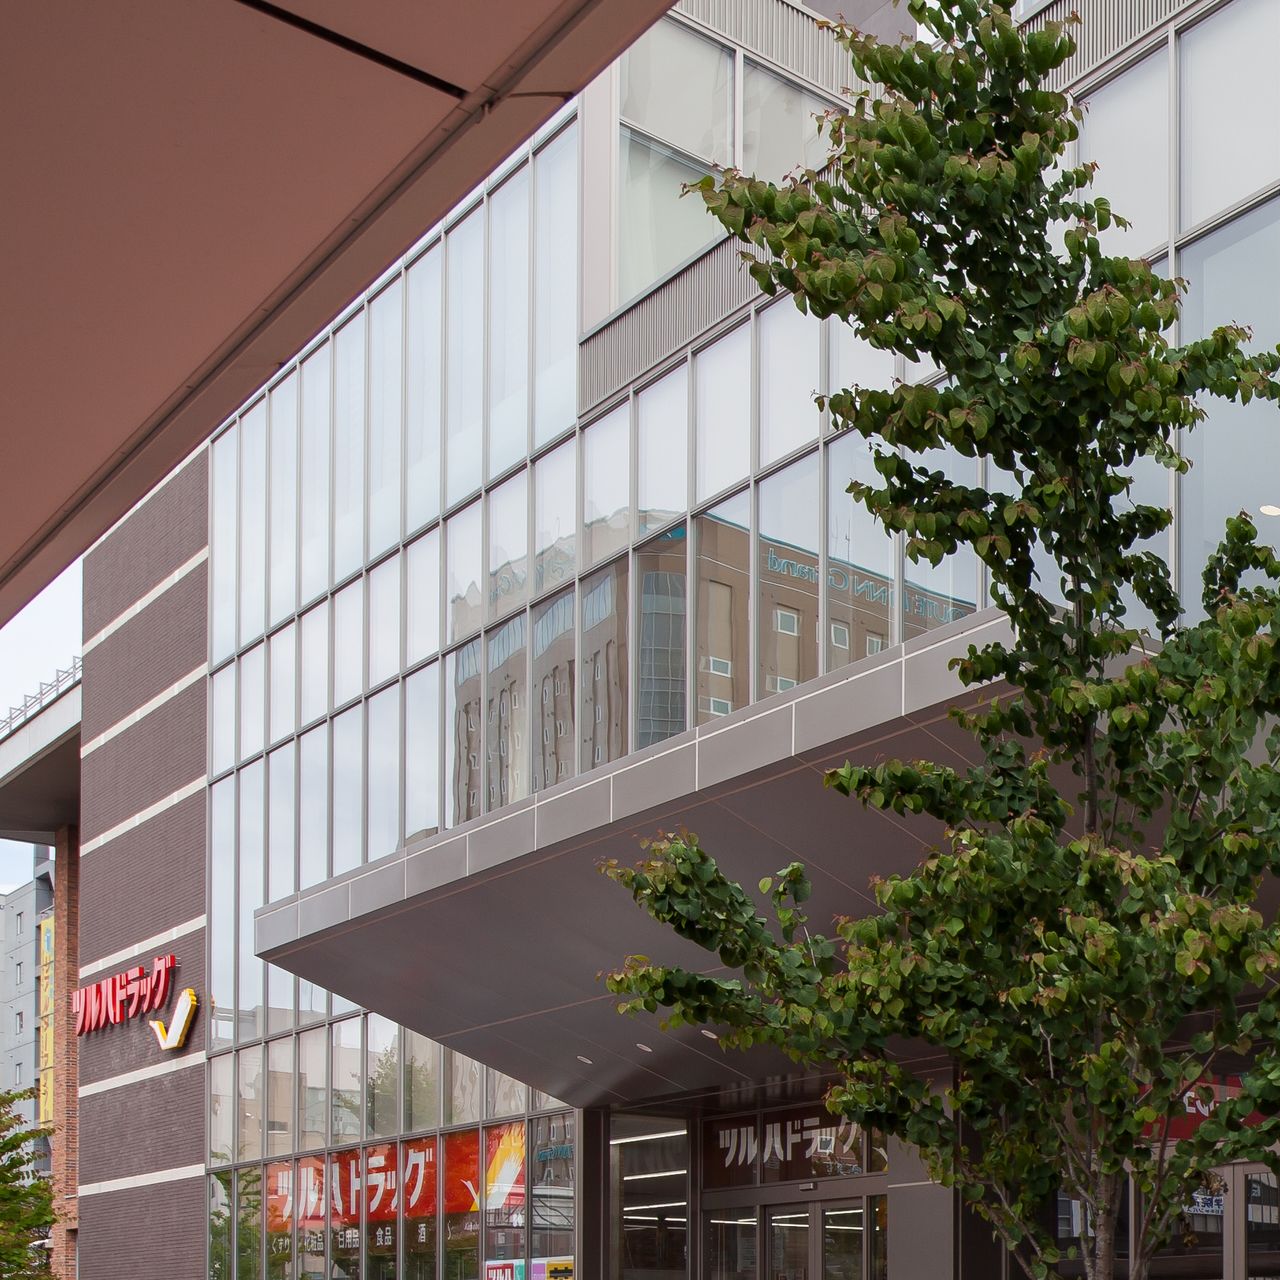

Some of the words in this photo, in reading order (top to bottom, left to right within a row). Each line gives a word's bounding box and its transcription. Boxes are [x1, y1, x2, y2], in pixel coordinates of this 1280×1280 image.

[72, 954, 177, 1036] ツルハドラッグ
[276, 1147, 433, 1223] ツルハドラッグ
[271, 1236, 290, 1254] くすり
[304, 1233, 324, 1252] 化粧品
[338, 1229, 360, 1249] 日用品
[375, 1226, 392, 1246] 食品
[417, 1223, 426, 1243] 酒
